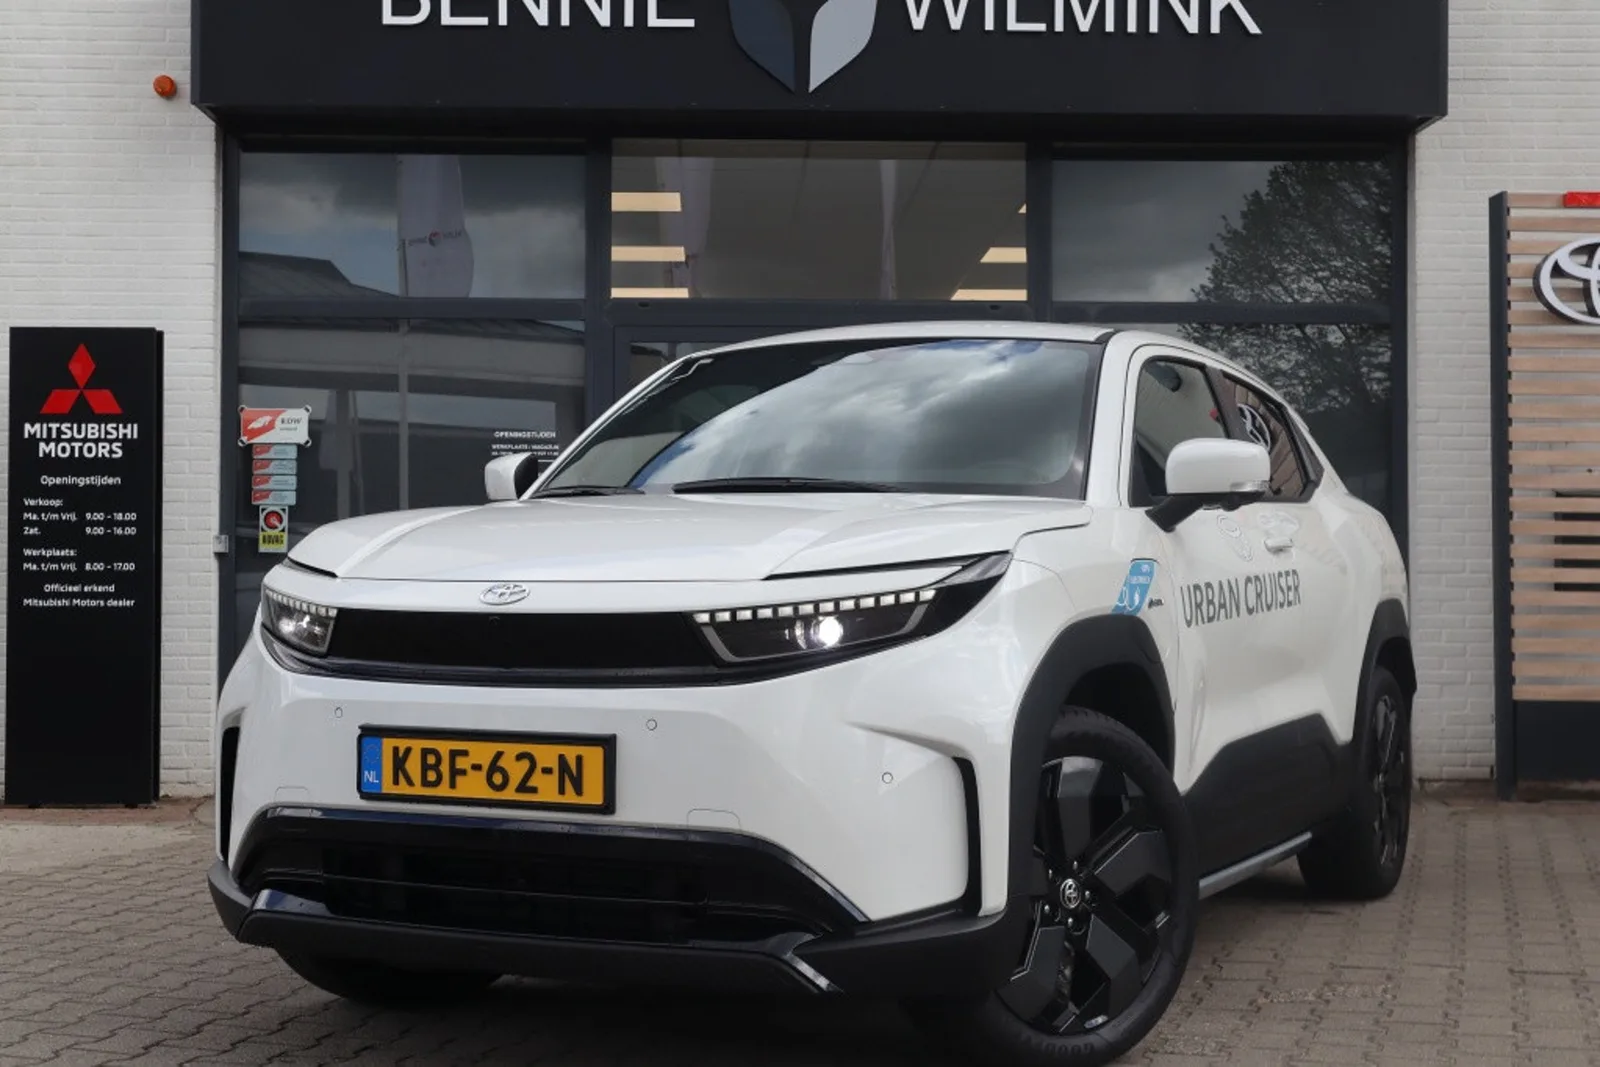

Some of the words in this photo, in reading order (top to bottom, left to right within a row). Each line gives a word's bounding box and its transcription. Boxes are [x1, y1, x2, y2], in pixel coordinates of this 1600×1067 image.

[23, 422, 138, 440] MITSUBISHI
[38, 441, 123, 459] MOTORS
[40, 475, 121, 487] Openingstijden
[23, 498, 63, 507] Verkoop:
[23, 512, 39, 520] Ma.
[41, 512, 59, 521] t/m
[85, 512, 104, 520] 9.00
[113, 512, 137, 520] 18.00
[23, 526, 41, 535] Zat.
[85, 526, 104, 535] 9.00
[113, 526, 137, 535] 16.00
[23, 548, 77, 557] Werkplaats:
[23, 562, 39, 570] Ma.
[41, 562, 58, 571] t/m
[85, 562, 104, 571] 8.00
[113, 562, 135, 571] 17.00
[43, 583, 82, 592] Officieel
[83, 583, 115, 592] erkend
[23, 598, 70, 606] Mitsubishi
[72, 598, 104, 606] Motors
[106, 598, 136, 606] dealer
[1180, 577, 1240, 628] URBAN
[1244, 568, 1301, 615] CRUISER
[391, 746, 584, 797] KBF-62-N
[363, 770, 379, 784] NL
